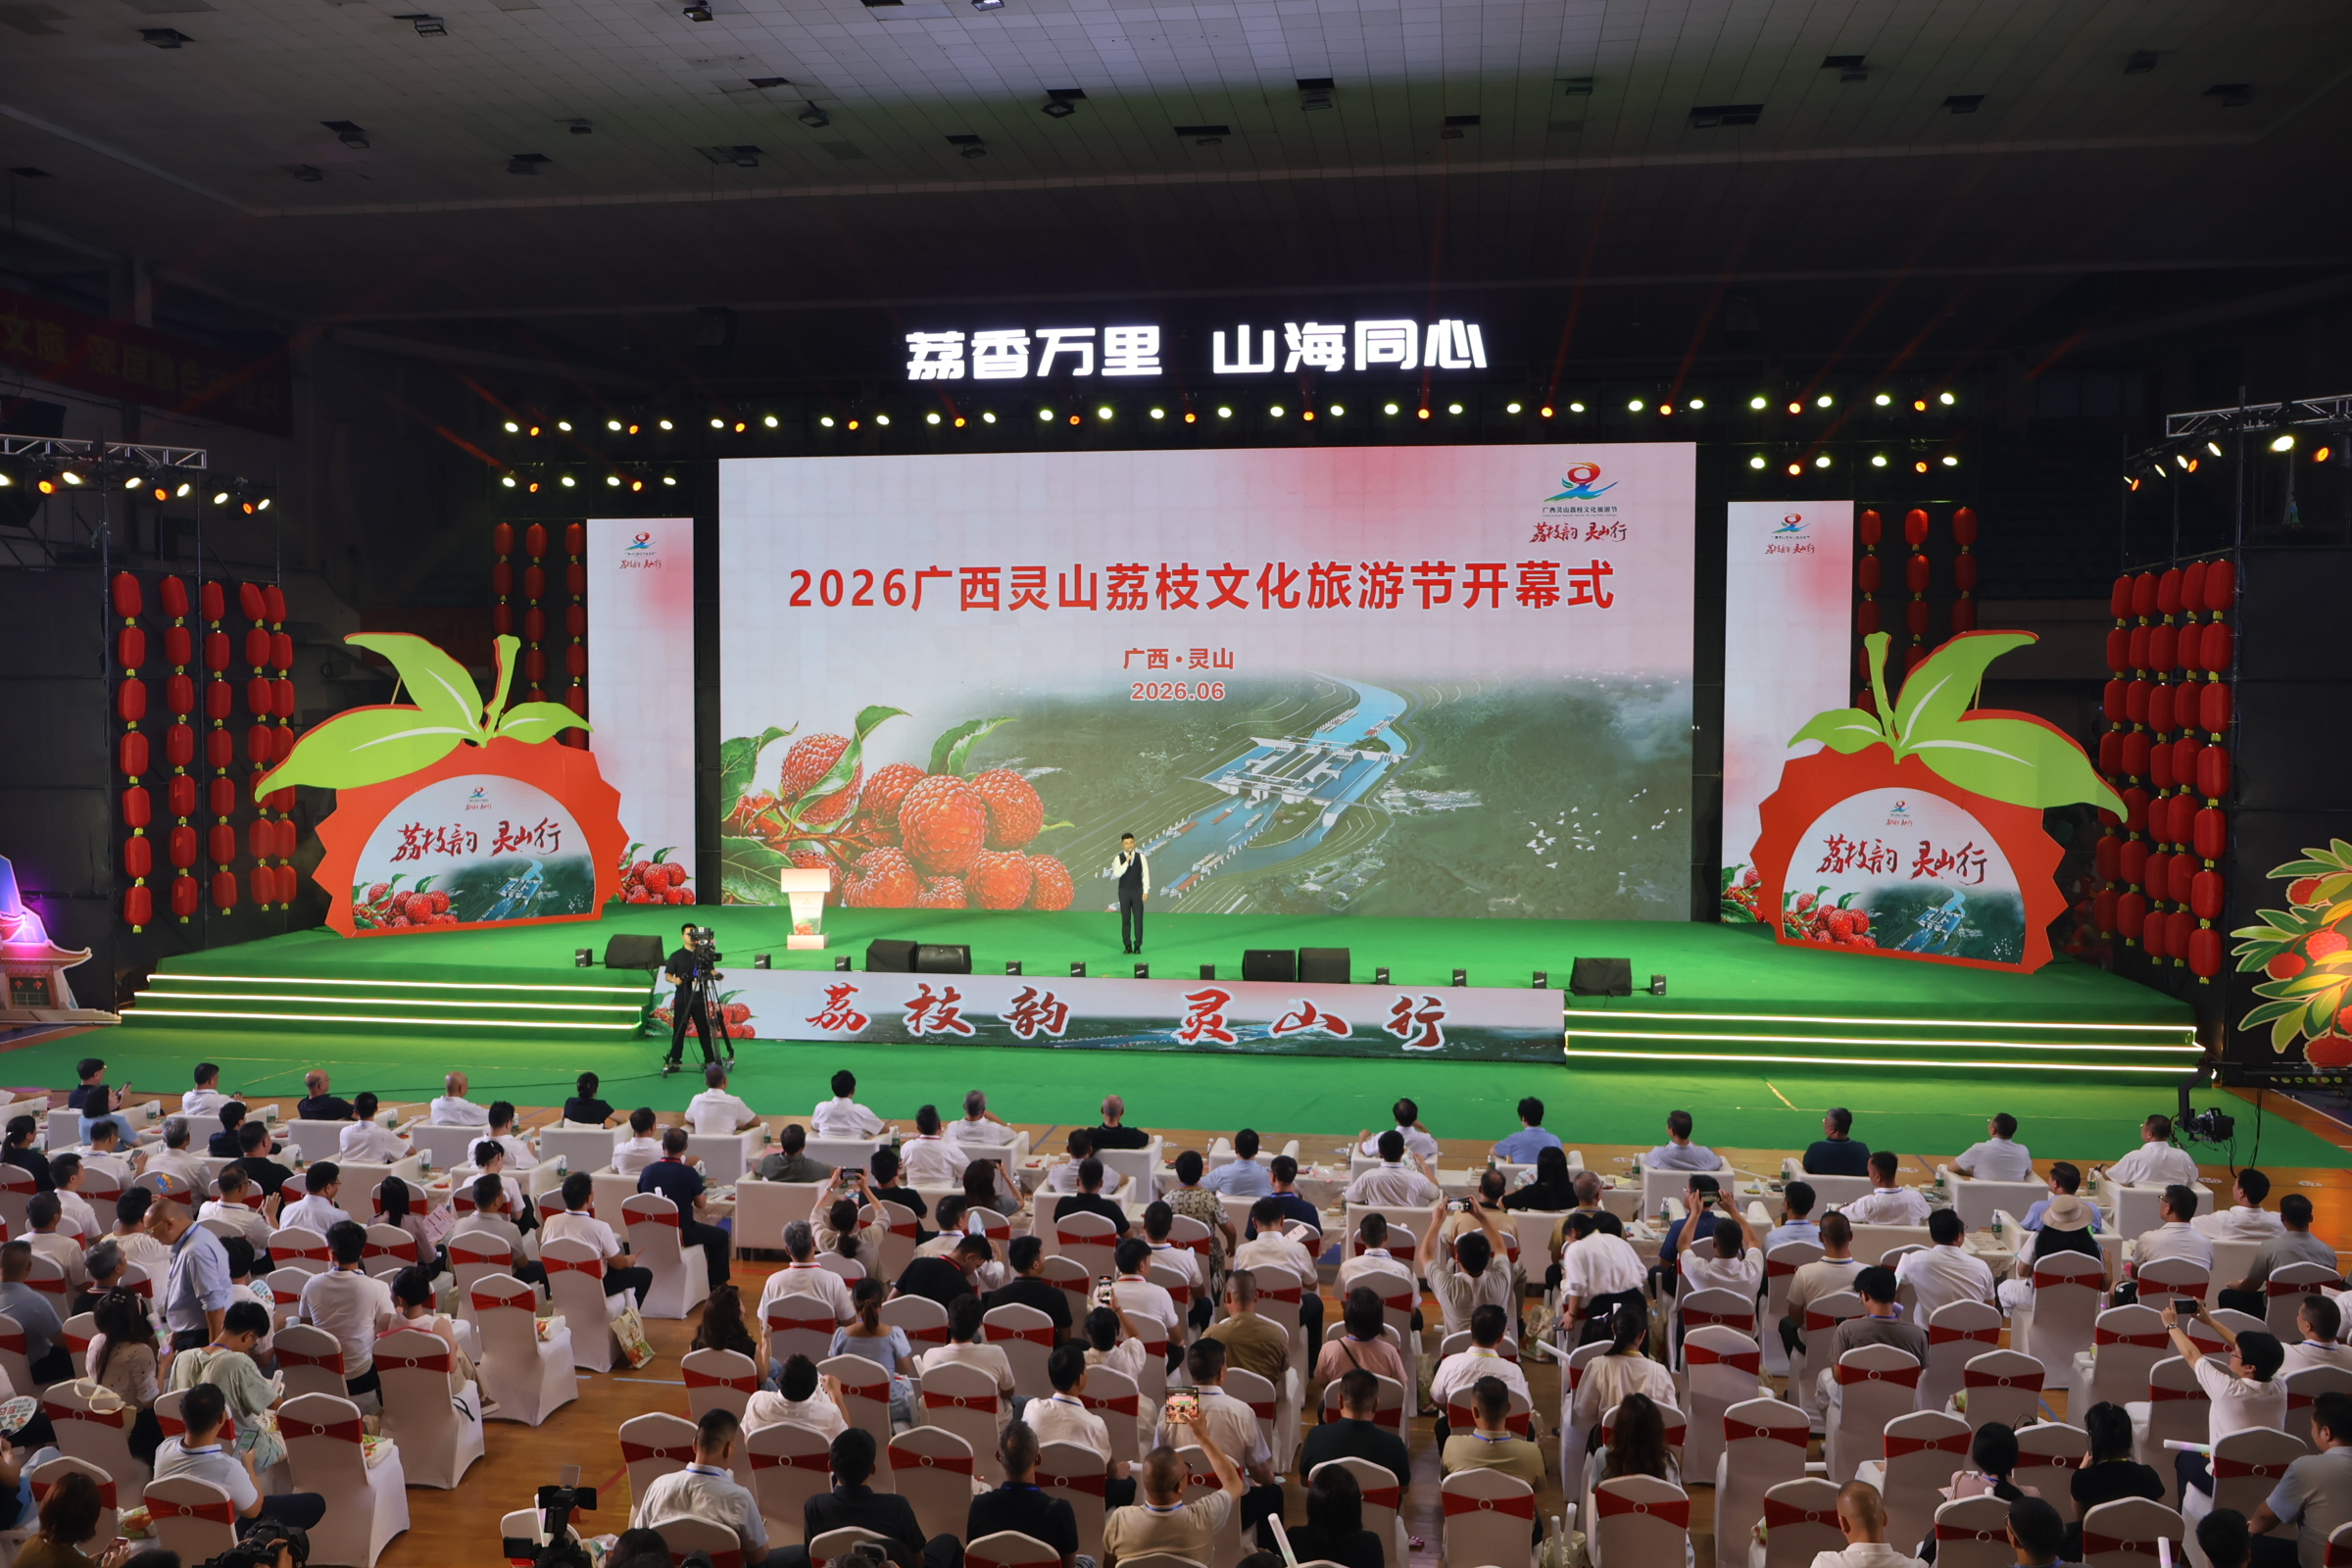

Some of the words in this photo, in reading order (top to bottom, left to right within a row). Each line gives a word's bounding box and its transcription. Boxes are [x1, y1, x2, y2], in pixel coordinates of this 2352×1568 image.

[906, 325, 1162, 380] 荔香万里
[1213, 319, 1488, 373] 山海同心
[1529, 521, 1579, 543] 荔枝韵
[1584, 520, 1628, 543] 灵山行
[789, 560, 1614, 612] 2026广西灵山荔枝文化旅游节开幕式
[1131, 682, 1225, 700] 2026.06
[390, 821, 478, 863] 荔枝韵
[490, 817, 562, 858] 灵山行
[1815, 833, 1898, 874] 荔枝韵
[1909, 840, 1987, 885] 灵山行
[806, 982, 1068, 1036] 荔枝韵
[1175, 988, 1446, 1048] 灵山行
